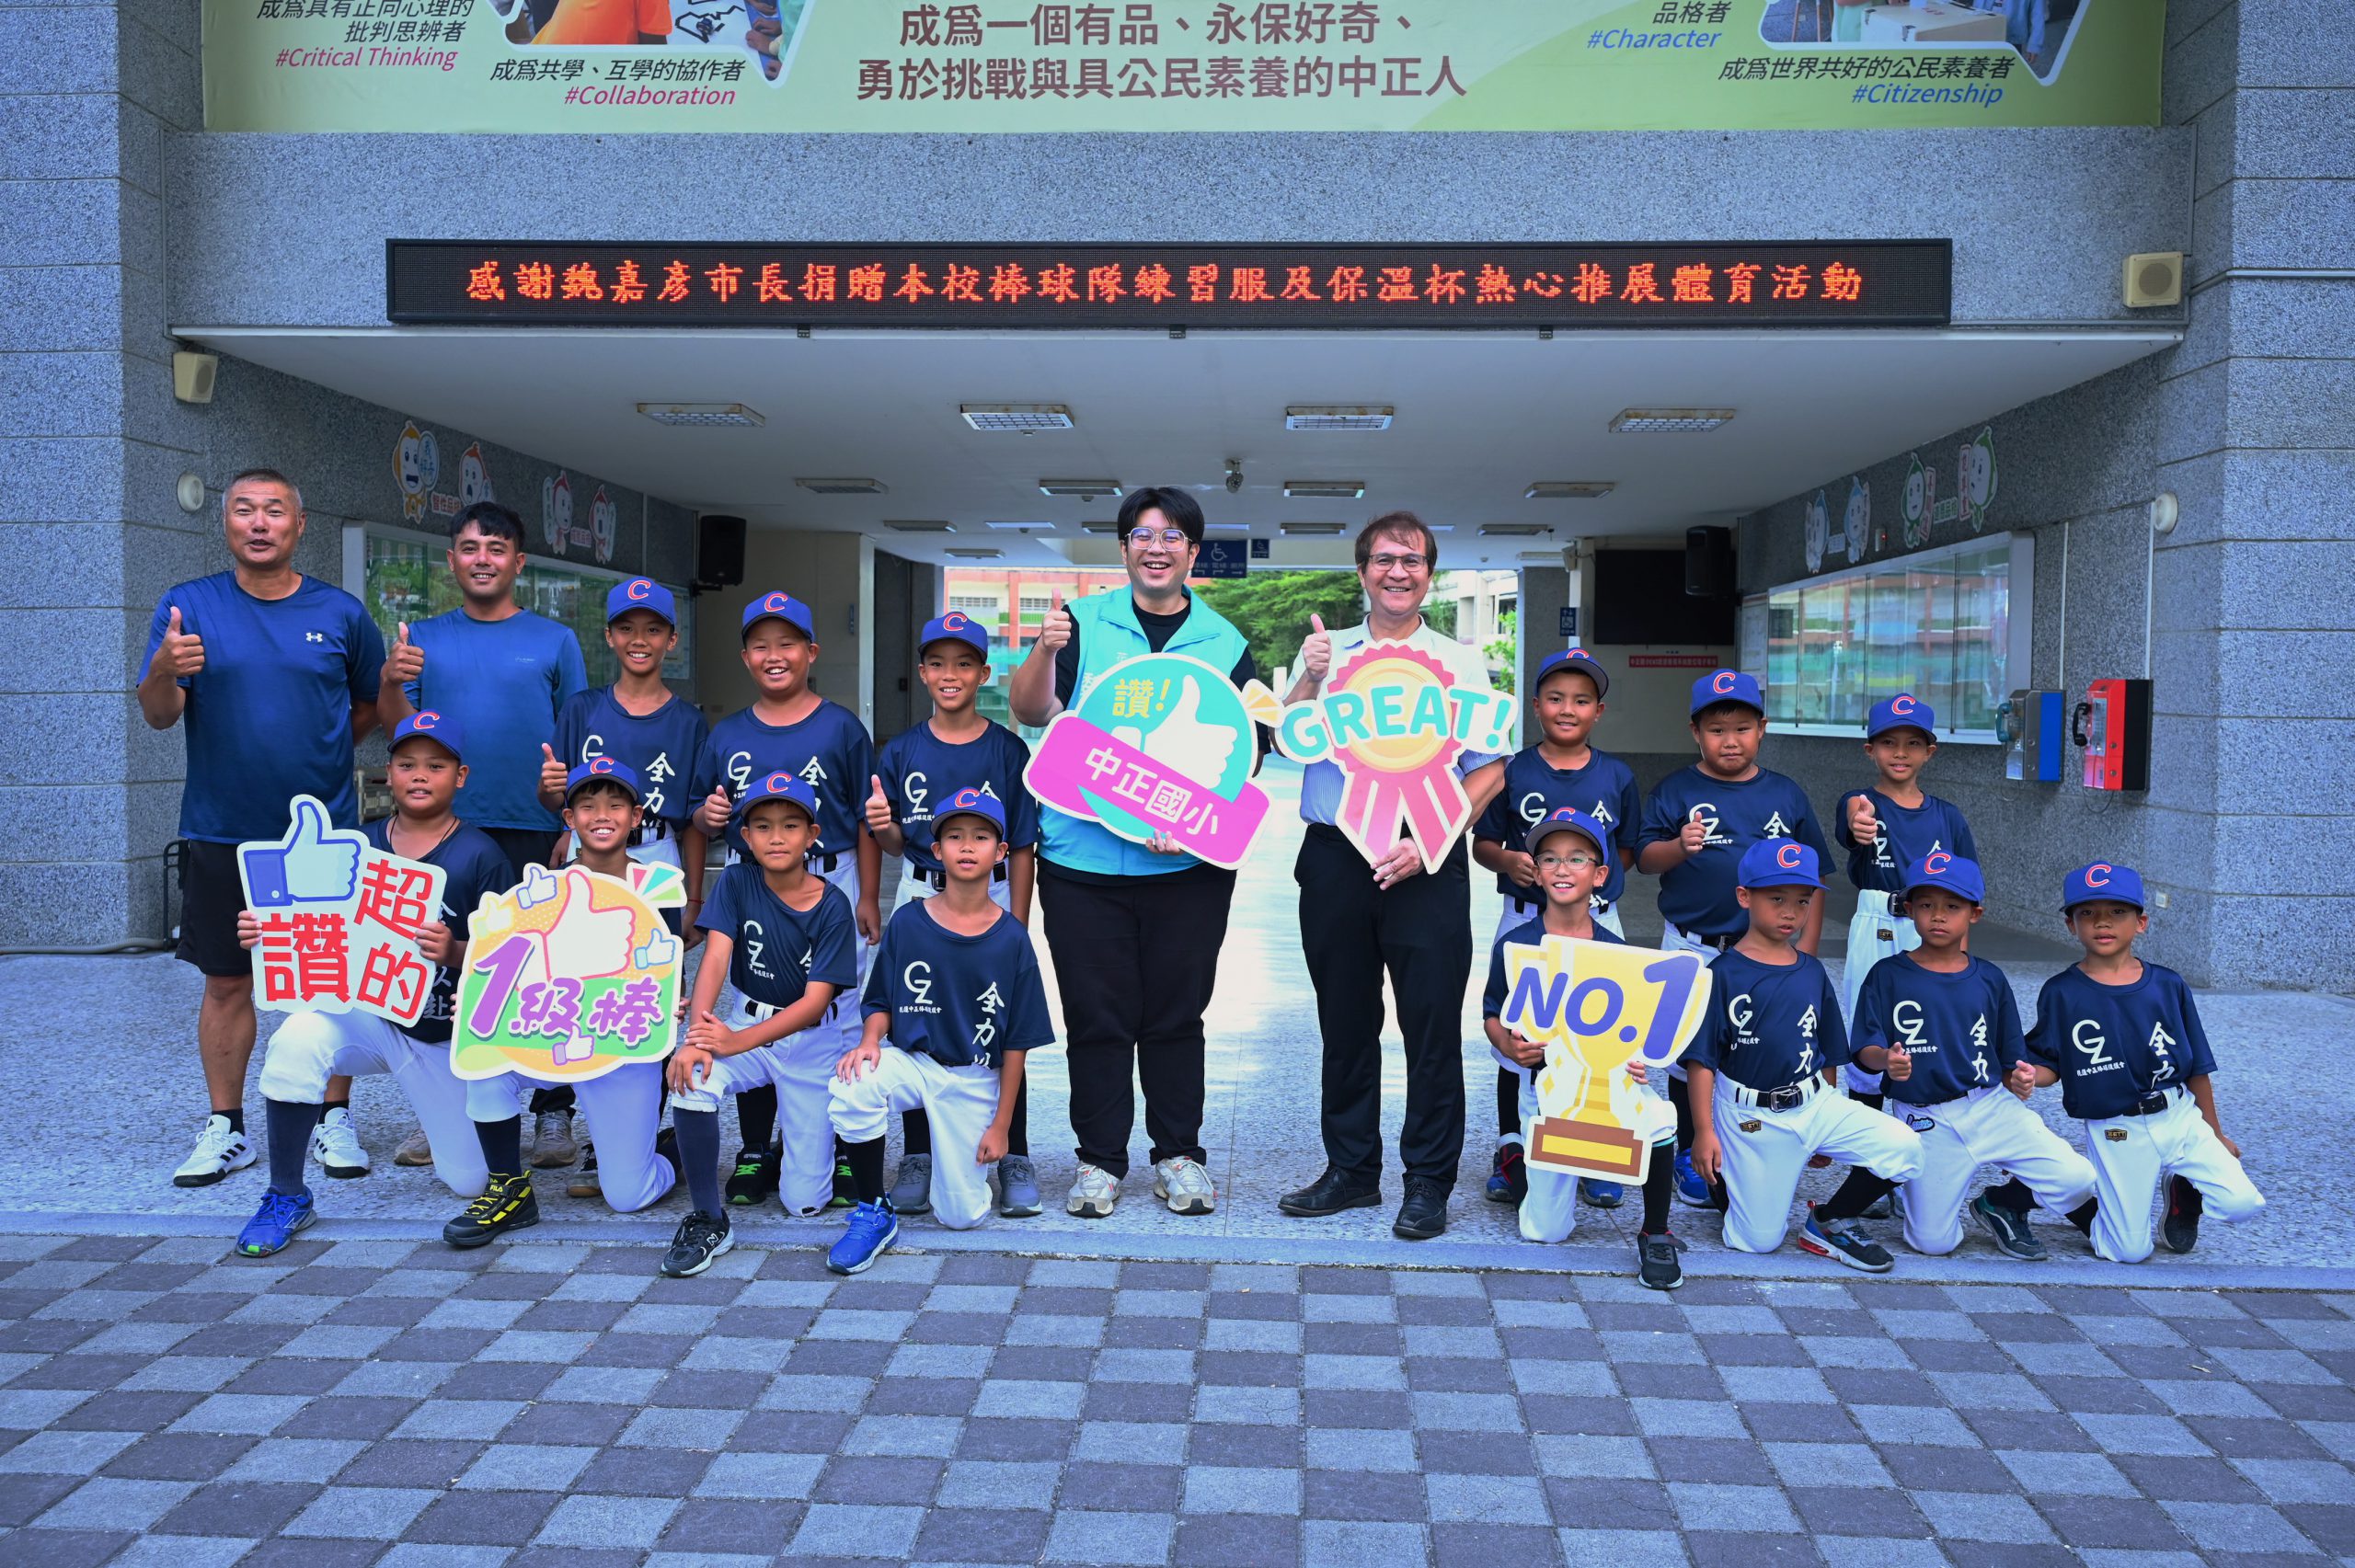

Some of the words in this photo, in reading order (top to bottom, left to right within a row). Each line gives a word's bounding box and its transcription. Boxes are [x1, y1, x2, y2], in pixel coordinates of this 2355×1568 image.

[1652, 1, 1731, 24] 品格者
[344, 20, 466, 43] 批判思辨者
[1587, 29, 1723, 49] #Character
[275, 46, 363, 67] #Critical
[369, 46, 459, 72] Thinking
[856, 55, 1468, 101] 勇於挑戰與具公民素養的中正人
[564, 84, 737, 106] #Collaboration
[1852, 82, 2005, 109] #Citizenship
[627, 579, 651, 600] C
[764, 592, 788, 612] C
[943, 612, 968, 632] C
[1712, 672, 1736, 694] C
[1891, 695, 1916, 715] C
[413, 711, 441, 730] C
[1281, 684, 1511, 750] GREAT!
[590, 756, 615, 774] C
[766, 773, 792, 794] C
[1084, 746, 1219, 836] 中正國小
[954, 788, 981, 808] C
[1776, 844, 1801, 868] C
[1924, 852, 1952, 875] C
[2085, 864, 2112, 887] C
[469, 935, 661, 1043] 1級棒
[1506, 955, 1700, 1060] NO.1
